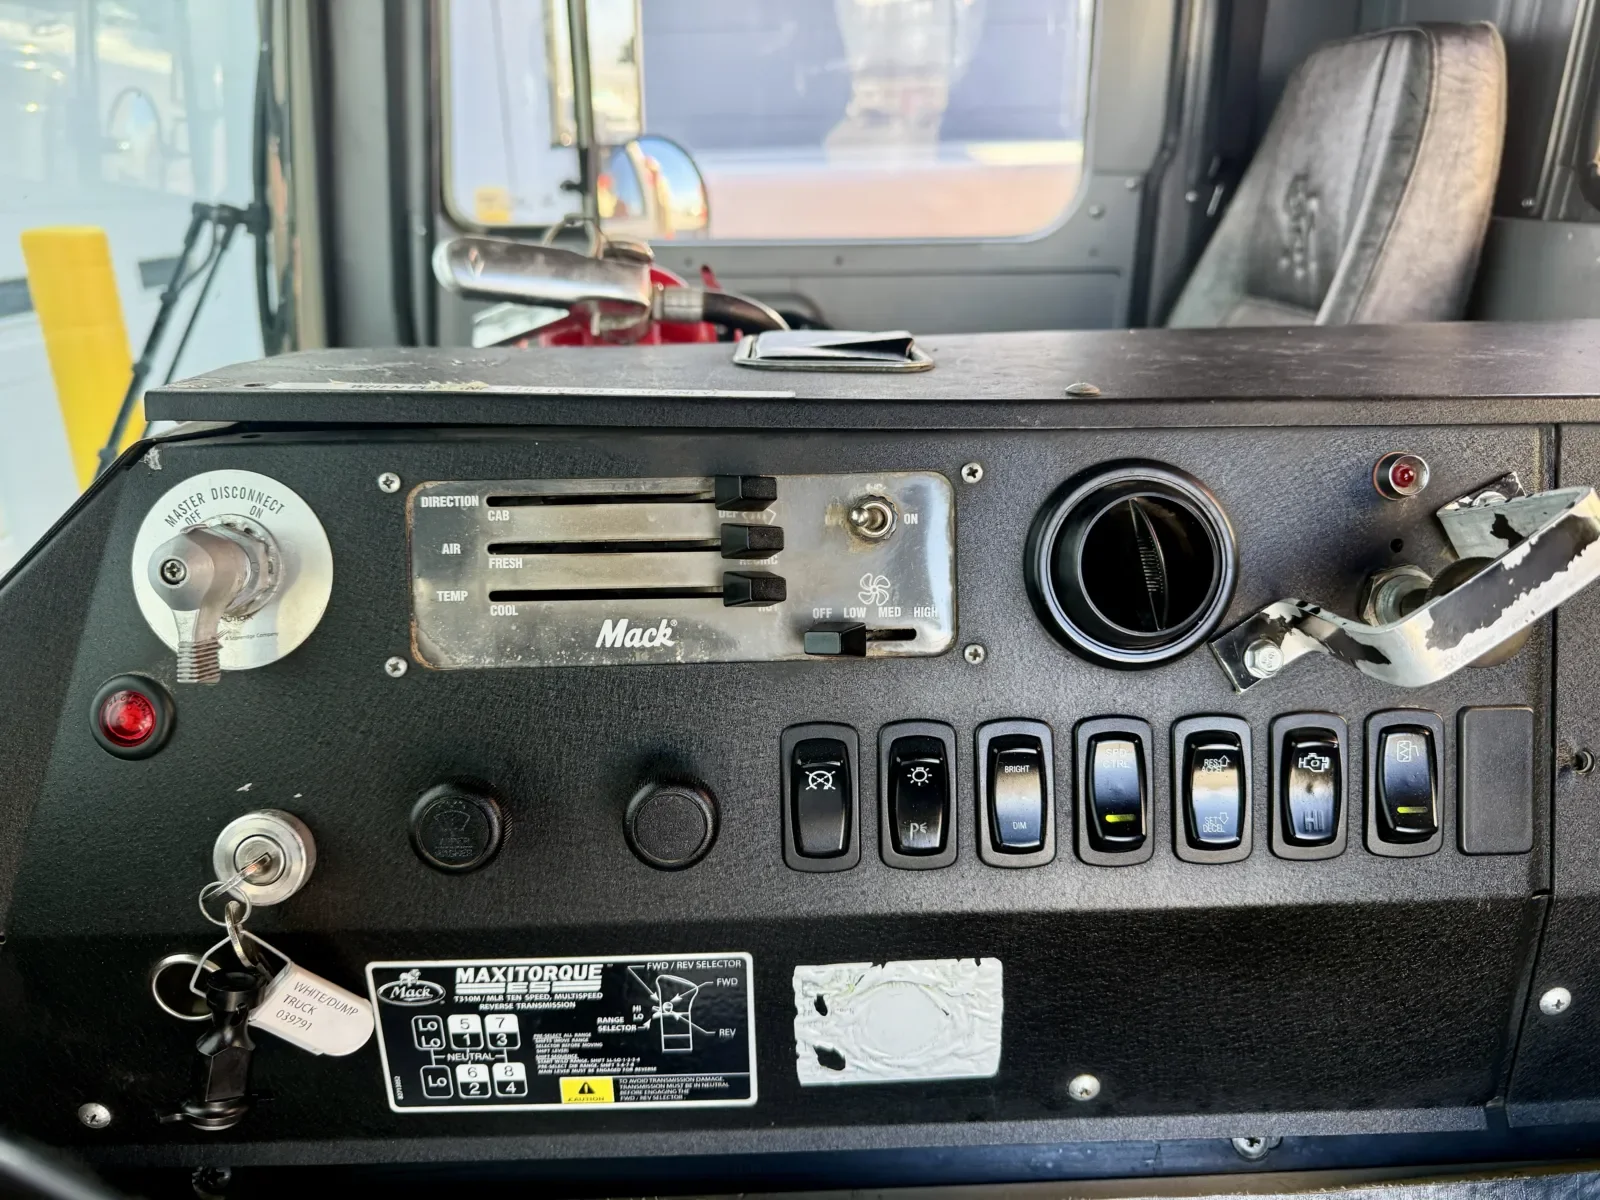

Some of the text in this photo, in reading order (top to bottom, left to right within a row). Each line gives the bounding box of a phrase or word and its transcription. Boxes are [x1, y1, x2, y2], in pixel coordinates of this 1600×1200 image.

[164, 486, 286, 528] MASTER DISCONNECT
[420, 495, 480, 508] DIRECTION
[185, 509, 202, 526] OFF
[249, 505, 264, 519] ON
[487, 510, 510, 522] CAB
[903, 513, 919, 525] ON
[441, 543, 461, 555] AIR
[488, 558, 523, 569] FRESH
[437, 591, 469, 602] TEMP
[490, 605, 519, 616] COOL
[812, 606, 939, 619] OFF LOW MED HIGH
[595, 618, 675, 648] Mack
[1105, 748, 1127, 757] SPD
[1203, 758, 1219, 767] RES
[1004, 764, 1030, 774] BRIGHT
[1201, 765, 1224, 773] ACCEL
[1012, 821, 1027, 830] DIM
[1204, 816, 1218, 825] SET
[1202, 824, 1225, 833] DECEL
[647, 961, 669, 971] FWD
[676, 961, 694, 969] REV
[696, 960, 742, 969] SELECTOR
[455, 963, 604, 983] MAXITORQUE
[716, 977, 738, 986] FWD
[293, 981, 359, 1016] WHITE/DUMP
[389, 985, 434, 1002] Mack
[486, 994, 504, 1002] MLR
[524, 993, 552, 1001] SPEED,
[554, 992, 604, 1000] MULTISPEED
[283, 994, 318, 1016] TRUCK
[479, 1001, 576, 1011] REVERSE TRANSMISSION
[632, 1004, 642, 1013] HI
[275, 1009, 313, 1031] 039791
[495, 1017, 505, 1028] 7
[597, 1016, 624, 1025] RANGE
[633, 1013, 644, 1021] LO
[418, 1018, 438, 1032] Lo
[460, 1018, 470, 1030] 5
[597, 1024, 637, 1033] SELECTOR
[719, 1028, 737, 1037] REV
[421, 1035, 441, 1048] Lo
[463, 1033, 471, 1046] 1
[496, 1033, 508, 1046] 3
[447, 1052, 495, 1062] NEUTRAL
[467, 1066, 478, 1078] 6
[504, 1065, 514, 1077] 8
[427, 1074, 447, 1087] Lo
[469, 1082, 480, 1095] 2
[505, 1081, 517, 1094] 4
